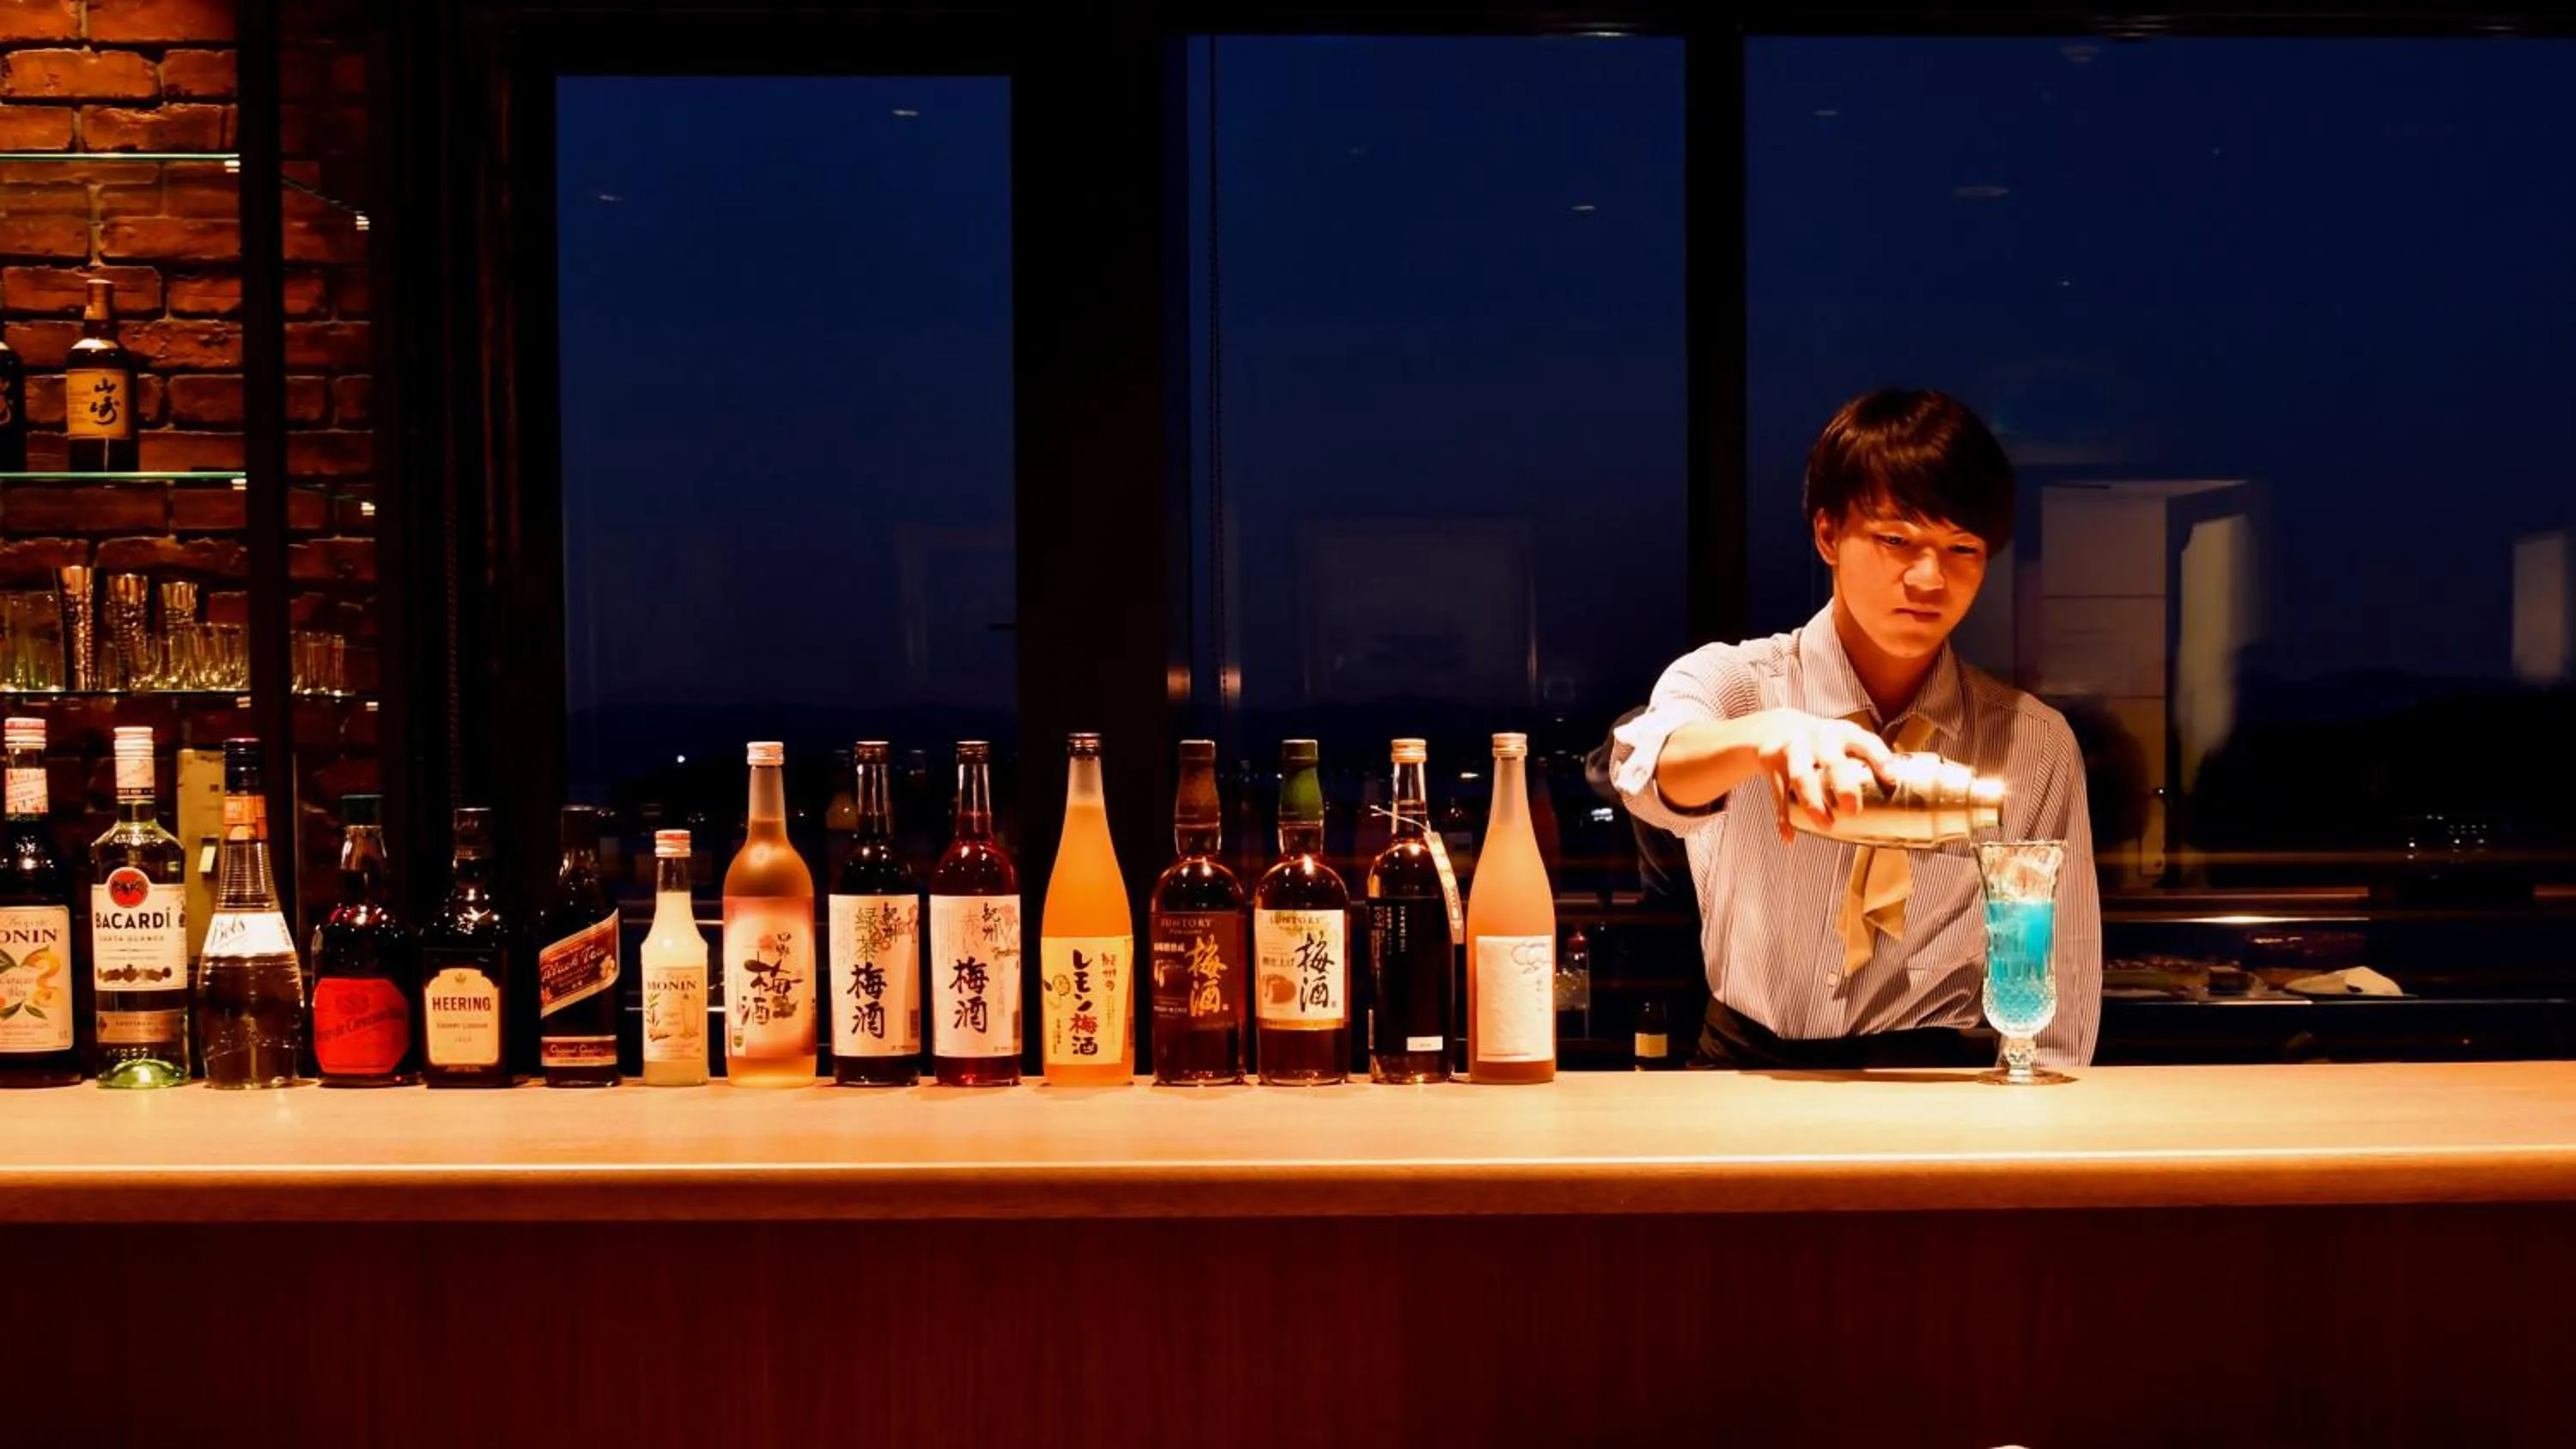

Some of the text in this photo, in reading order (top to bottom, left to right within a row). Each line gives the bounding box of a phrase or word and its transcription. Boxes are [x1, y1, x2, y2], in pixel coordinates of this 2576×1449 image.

[89, 378, 120, 425] 山崎
[0, 929, 57, 943] ONIN
[432, 997, 491, 1011] HEERING
